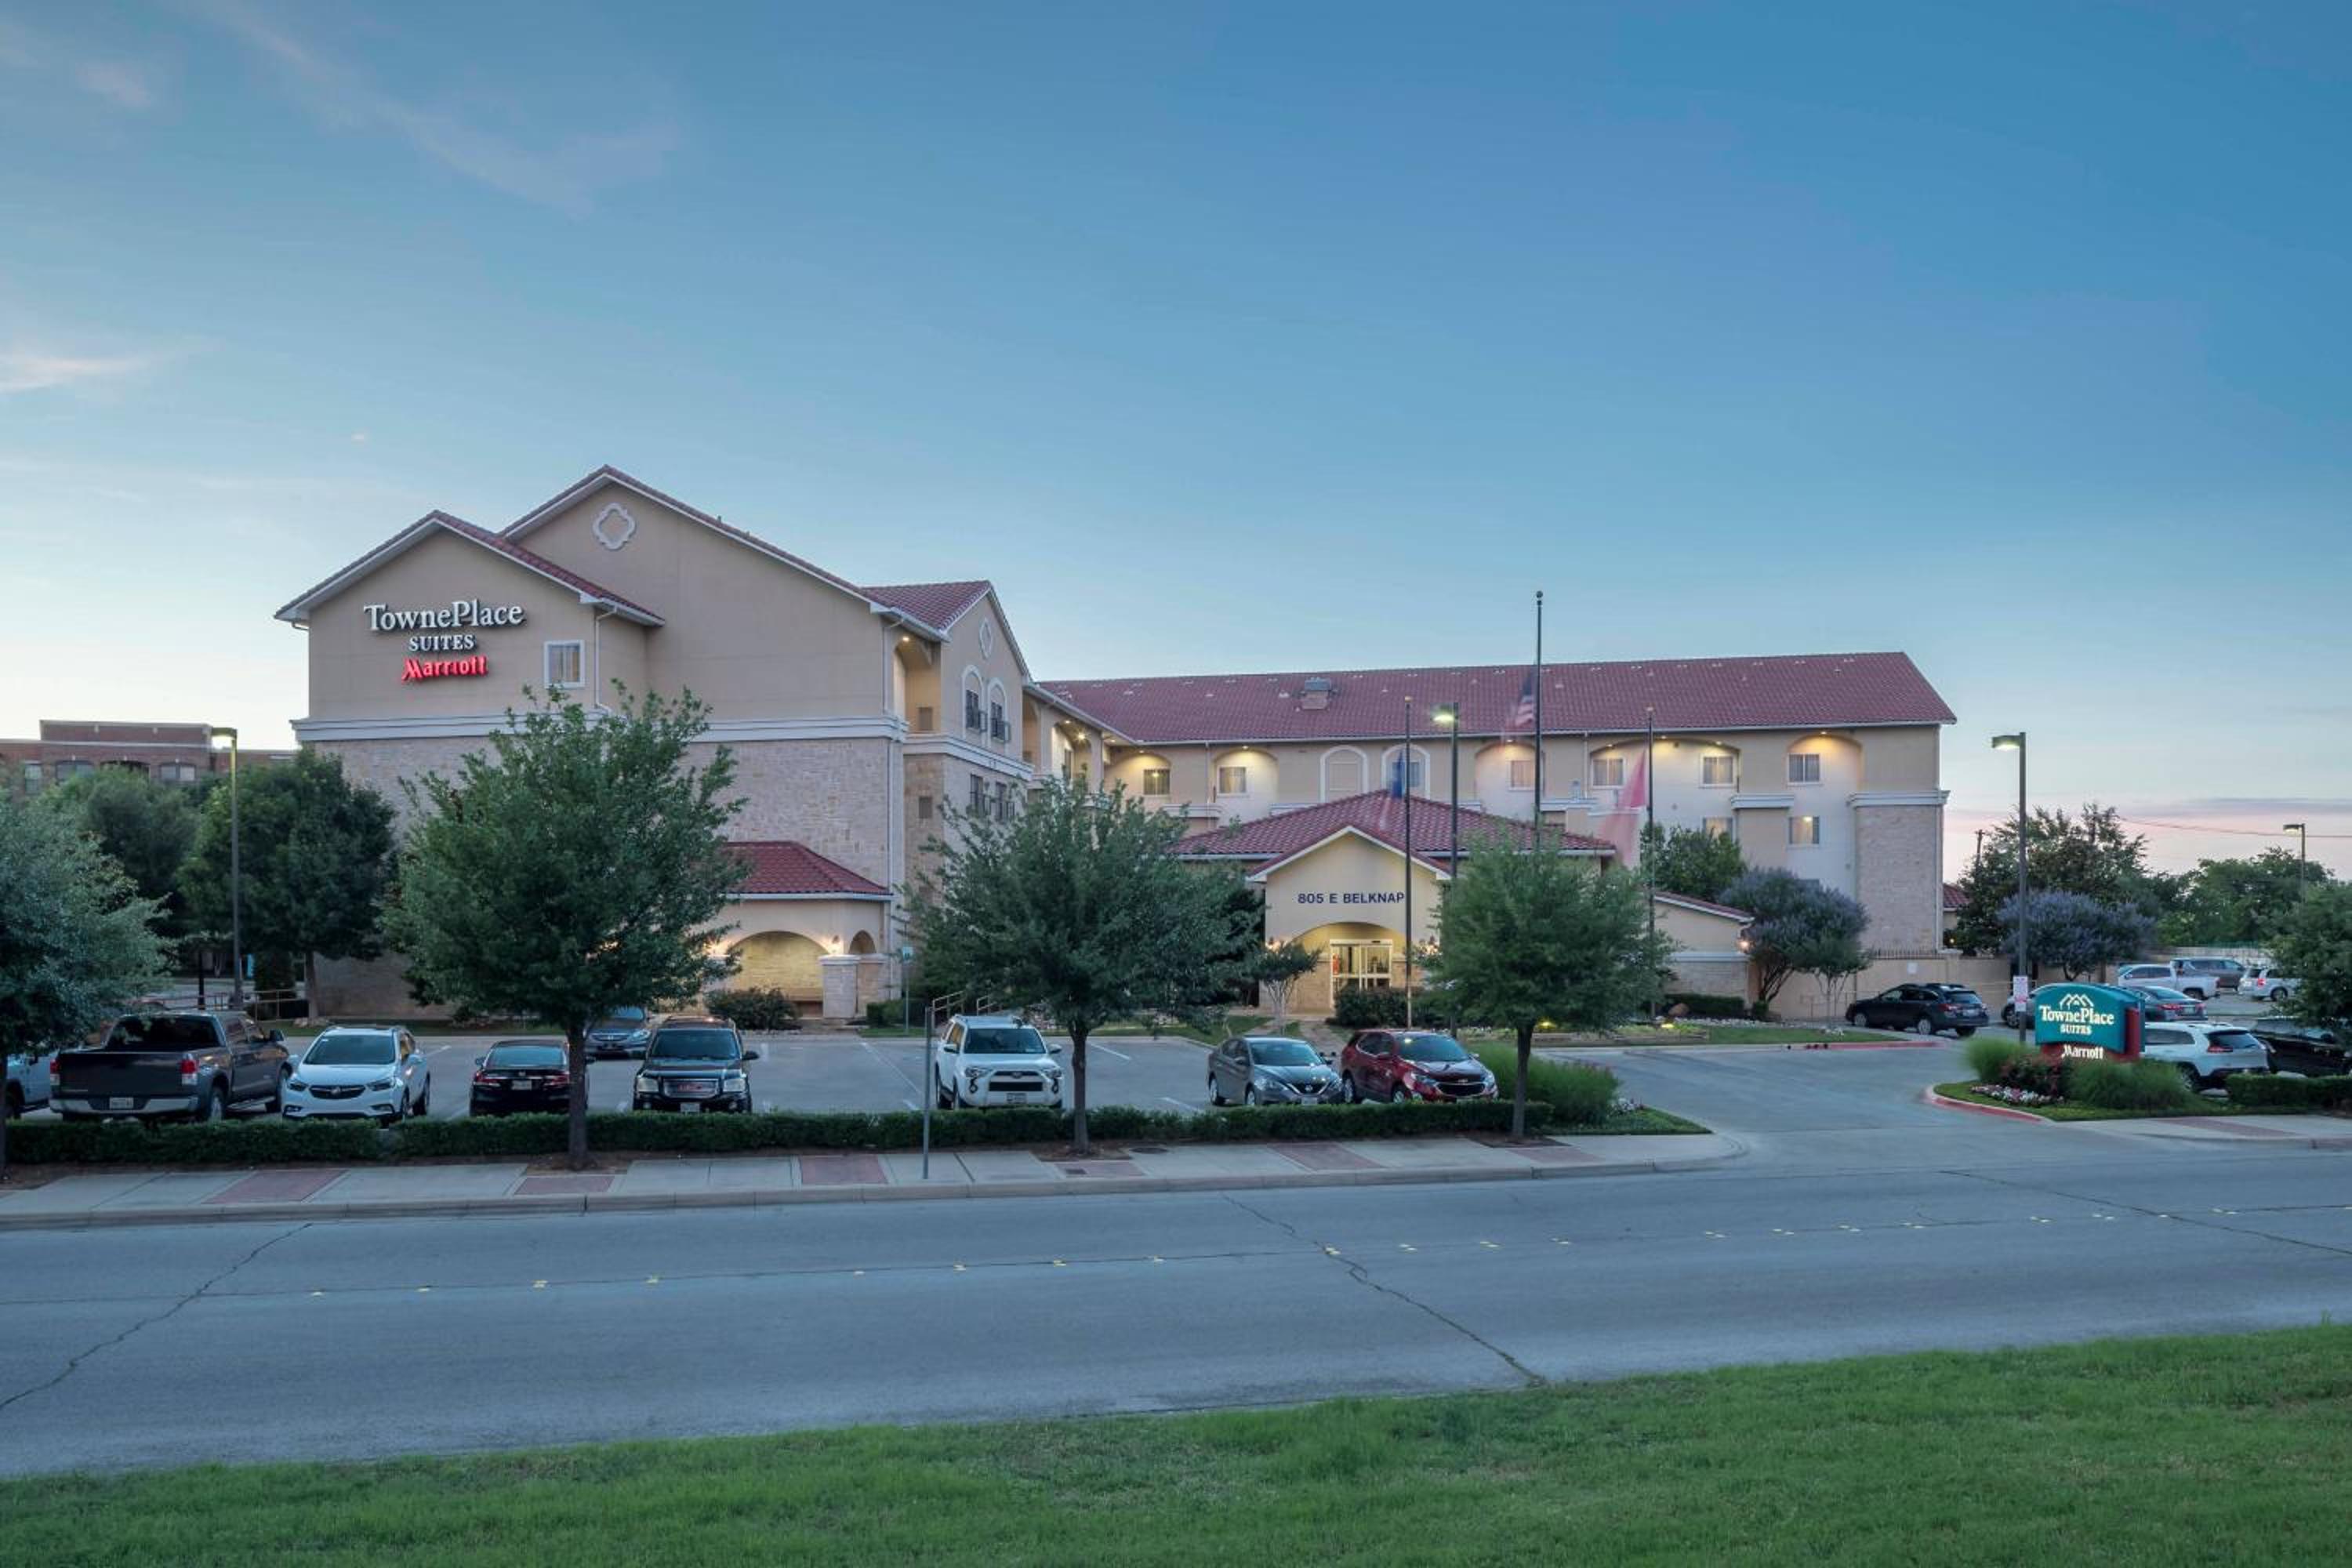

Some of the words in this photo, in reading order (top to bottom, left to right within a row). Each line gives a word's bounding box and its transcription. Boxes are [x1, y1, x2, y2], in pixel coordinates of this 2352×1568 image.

[363, 599, 526, 630] TownePlace
[408, 633, 476, 652] SUITES
[401, 655, 488, 681] Marriott
[1298, 893, 1324, 904] 805
[1329, 893, 1338, 904] E
[1343, 892, 1405, 904] BELKNAP
[2039, 1005, 2114, 1025] TownePlace
[2061, 1044, 2103, 1059] Marriott
